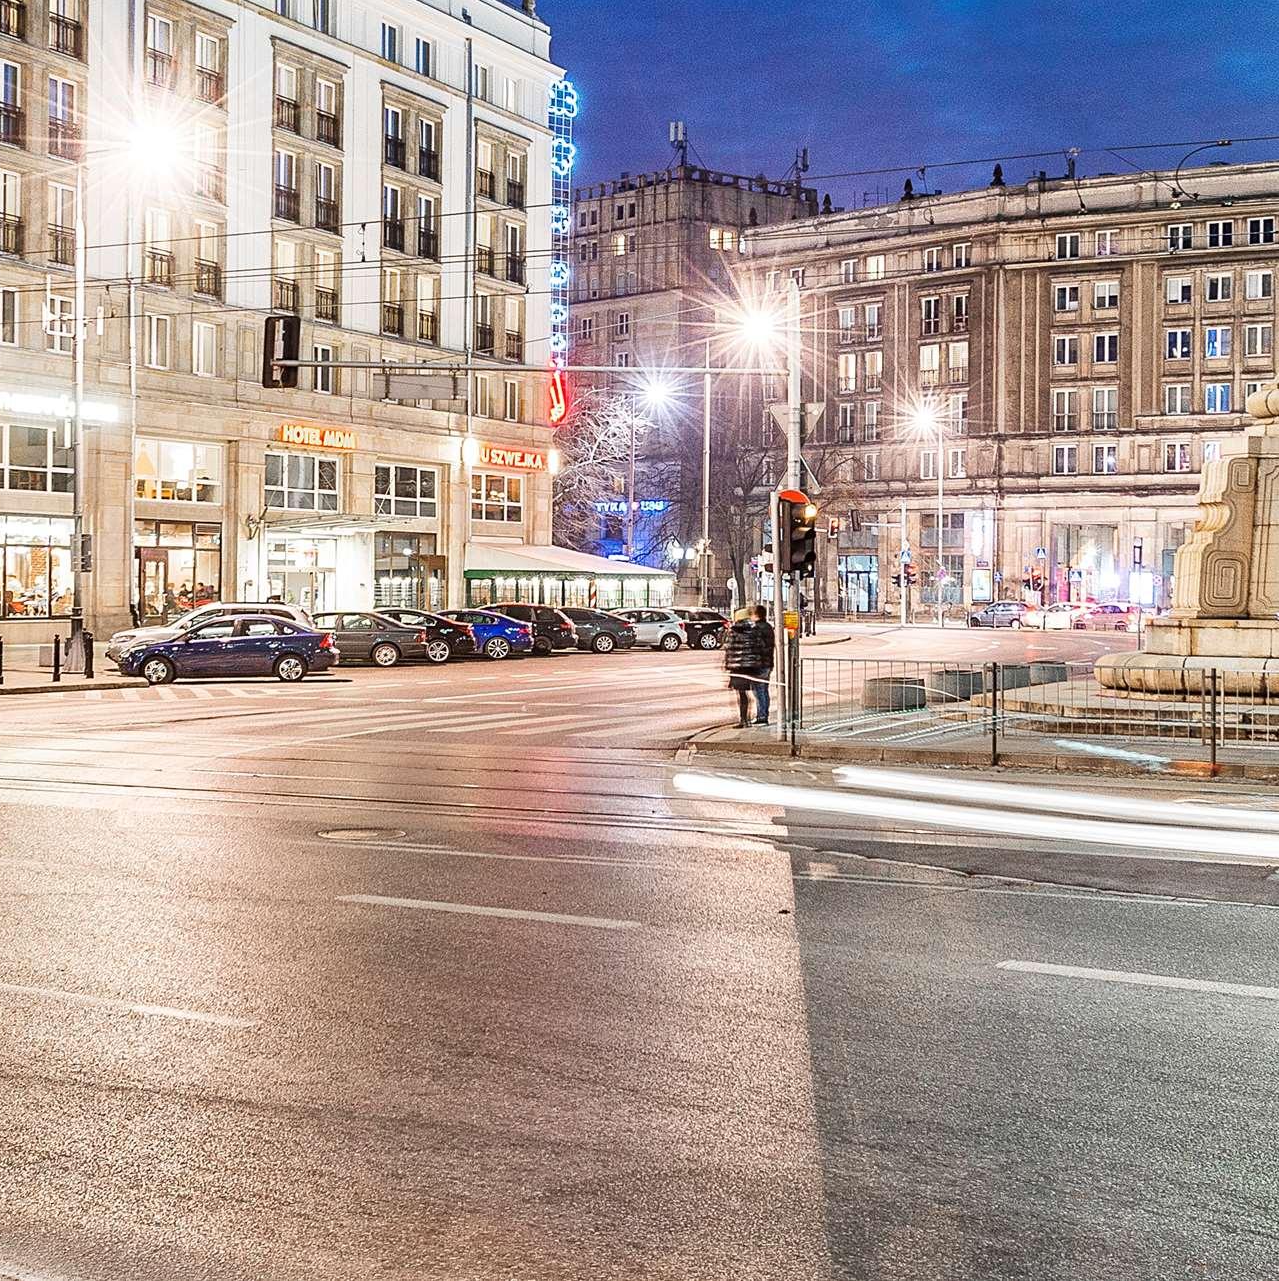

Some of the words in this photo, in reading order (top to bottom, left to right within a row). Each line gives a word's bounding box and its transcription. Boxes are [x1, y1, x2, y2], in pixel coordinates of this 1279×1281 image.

[281, 424, 323, 446] HOTEL
[323, 430, 356, 450] MDM
[481, 447, 490, 463] U
[490, 448, 543, 469] SZWEJKA
